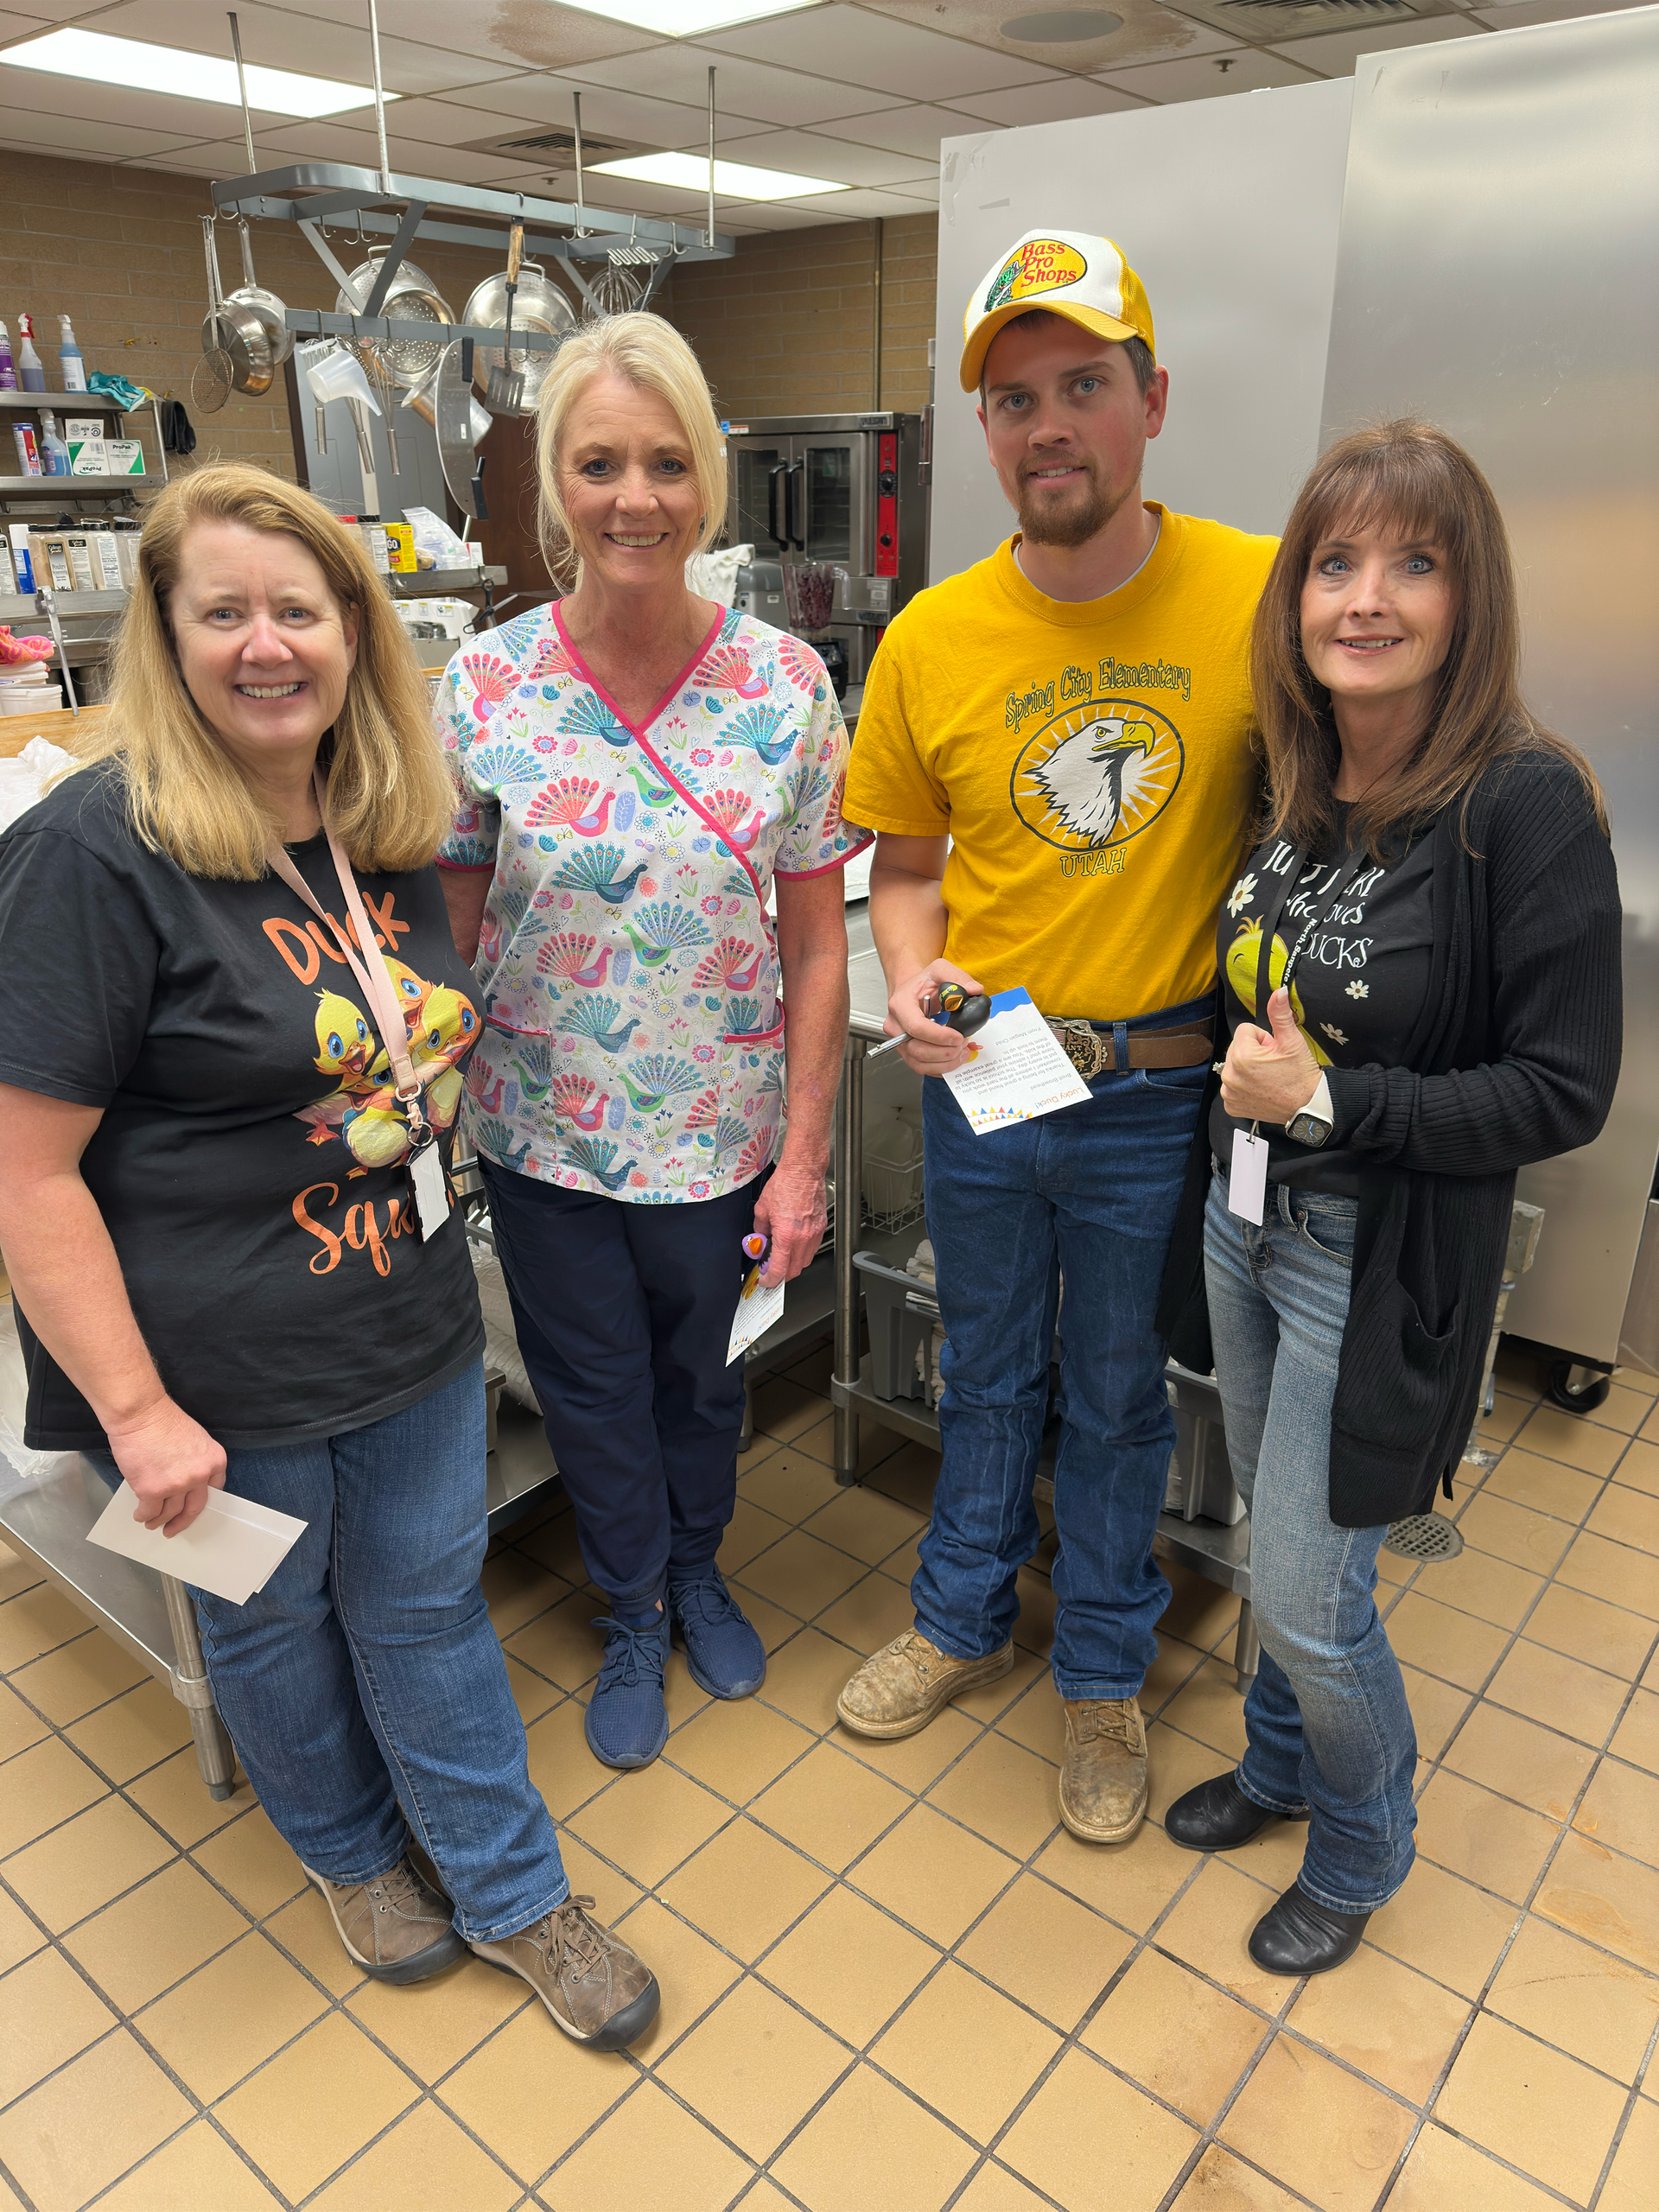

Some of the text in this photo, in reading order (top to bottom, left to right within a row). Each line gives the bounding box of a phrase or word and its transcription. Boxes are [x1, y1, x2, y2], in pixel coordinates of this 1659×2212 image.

[1021, 244, 1065, 260] Bass
[1023, 257, 1053, 272] Pro
[1020, 269, 1077, 288] Shops
[1005, 657, 1191, 734] Spring City Elementary
[1059, 848, 1127, 877] UTAH
[1262, 840, 1328, 884] JUT
[1283, 918, 1319, 982] North Sanpete
[1008, 1032, 1027, 1040] Megan
[1007, 1057, 1026, 1065] admire
[1045, 1063, 1064, 1071] Thanks
[962, 1065, 984, 1075] example
[973, 1066, 995, 1077] patience
[988, 1070, 1005, 1078] school
[1014, 1067, 1033, 1076] admire
[1029, 1077, 1058, 1090] Broadhead
[1033, 1086, 1084, 1109] Lucky Duck!
[292, 1173, 454, 1277] Squ
